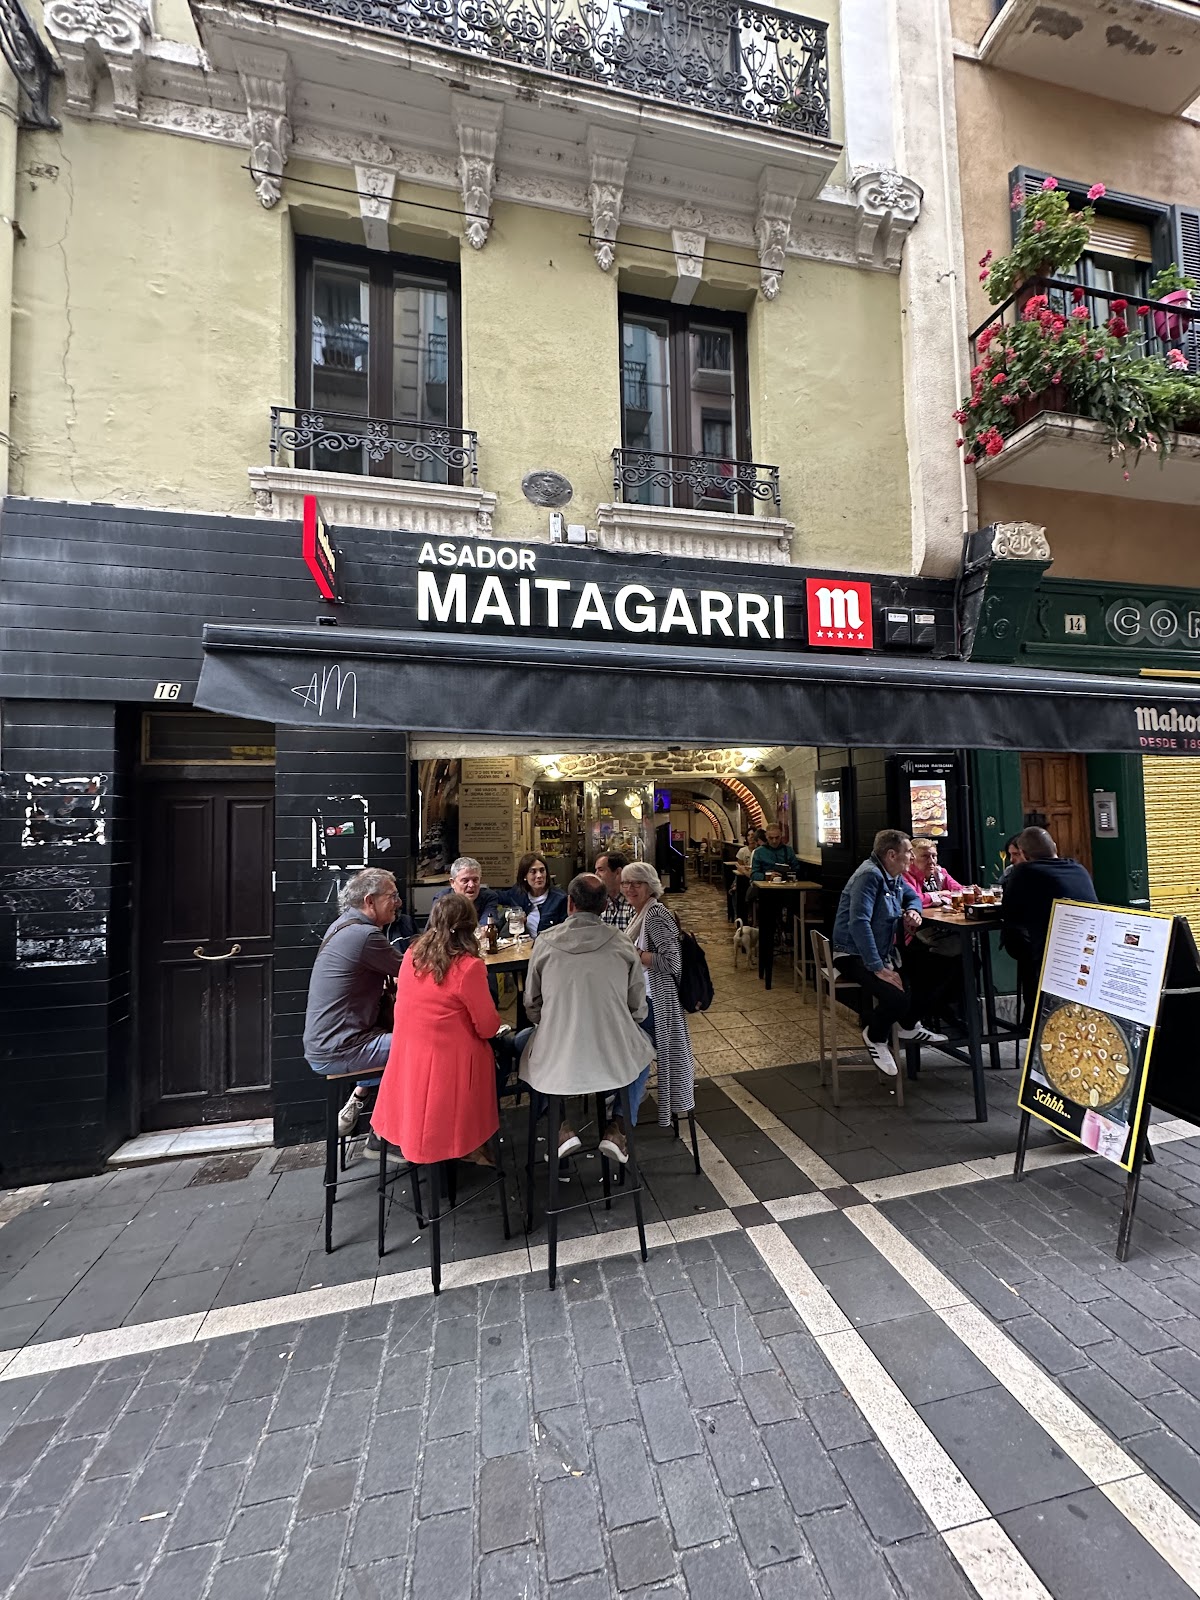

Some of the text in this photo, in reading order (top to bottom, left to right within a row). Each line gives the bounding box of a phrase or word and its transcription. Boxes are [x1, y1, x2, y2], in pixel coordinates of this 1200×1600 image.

[418, 541, 537, 572] ASADOR
[417, 570, 785, 640] MAITAGARRI
[1069, 617, 1083, 631] 14
[156, 684, 180, 699] 16
[1139, 736, 1178, 749] DESDE
